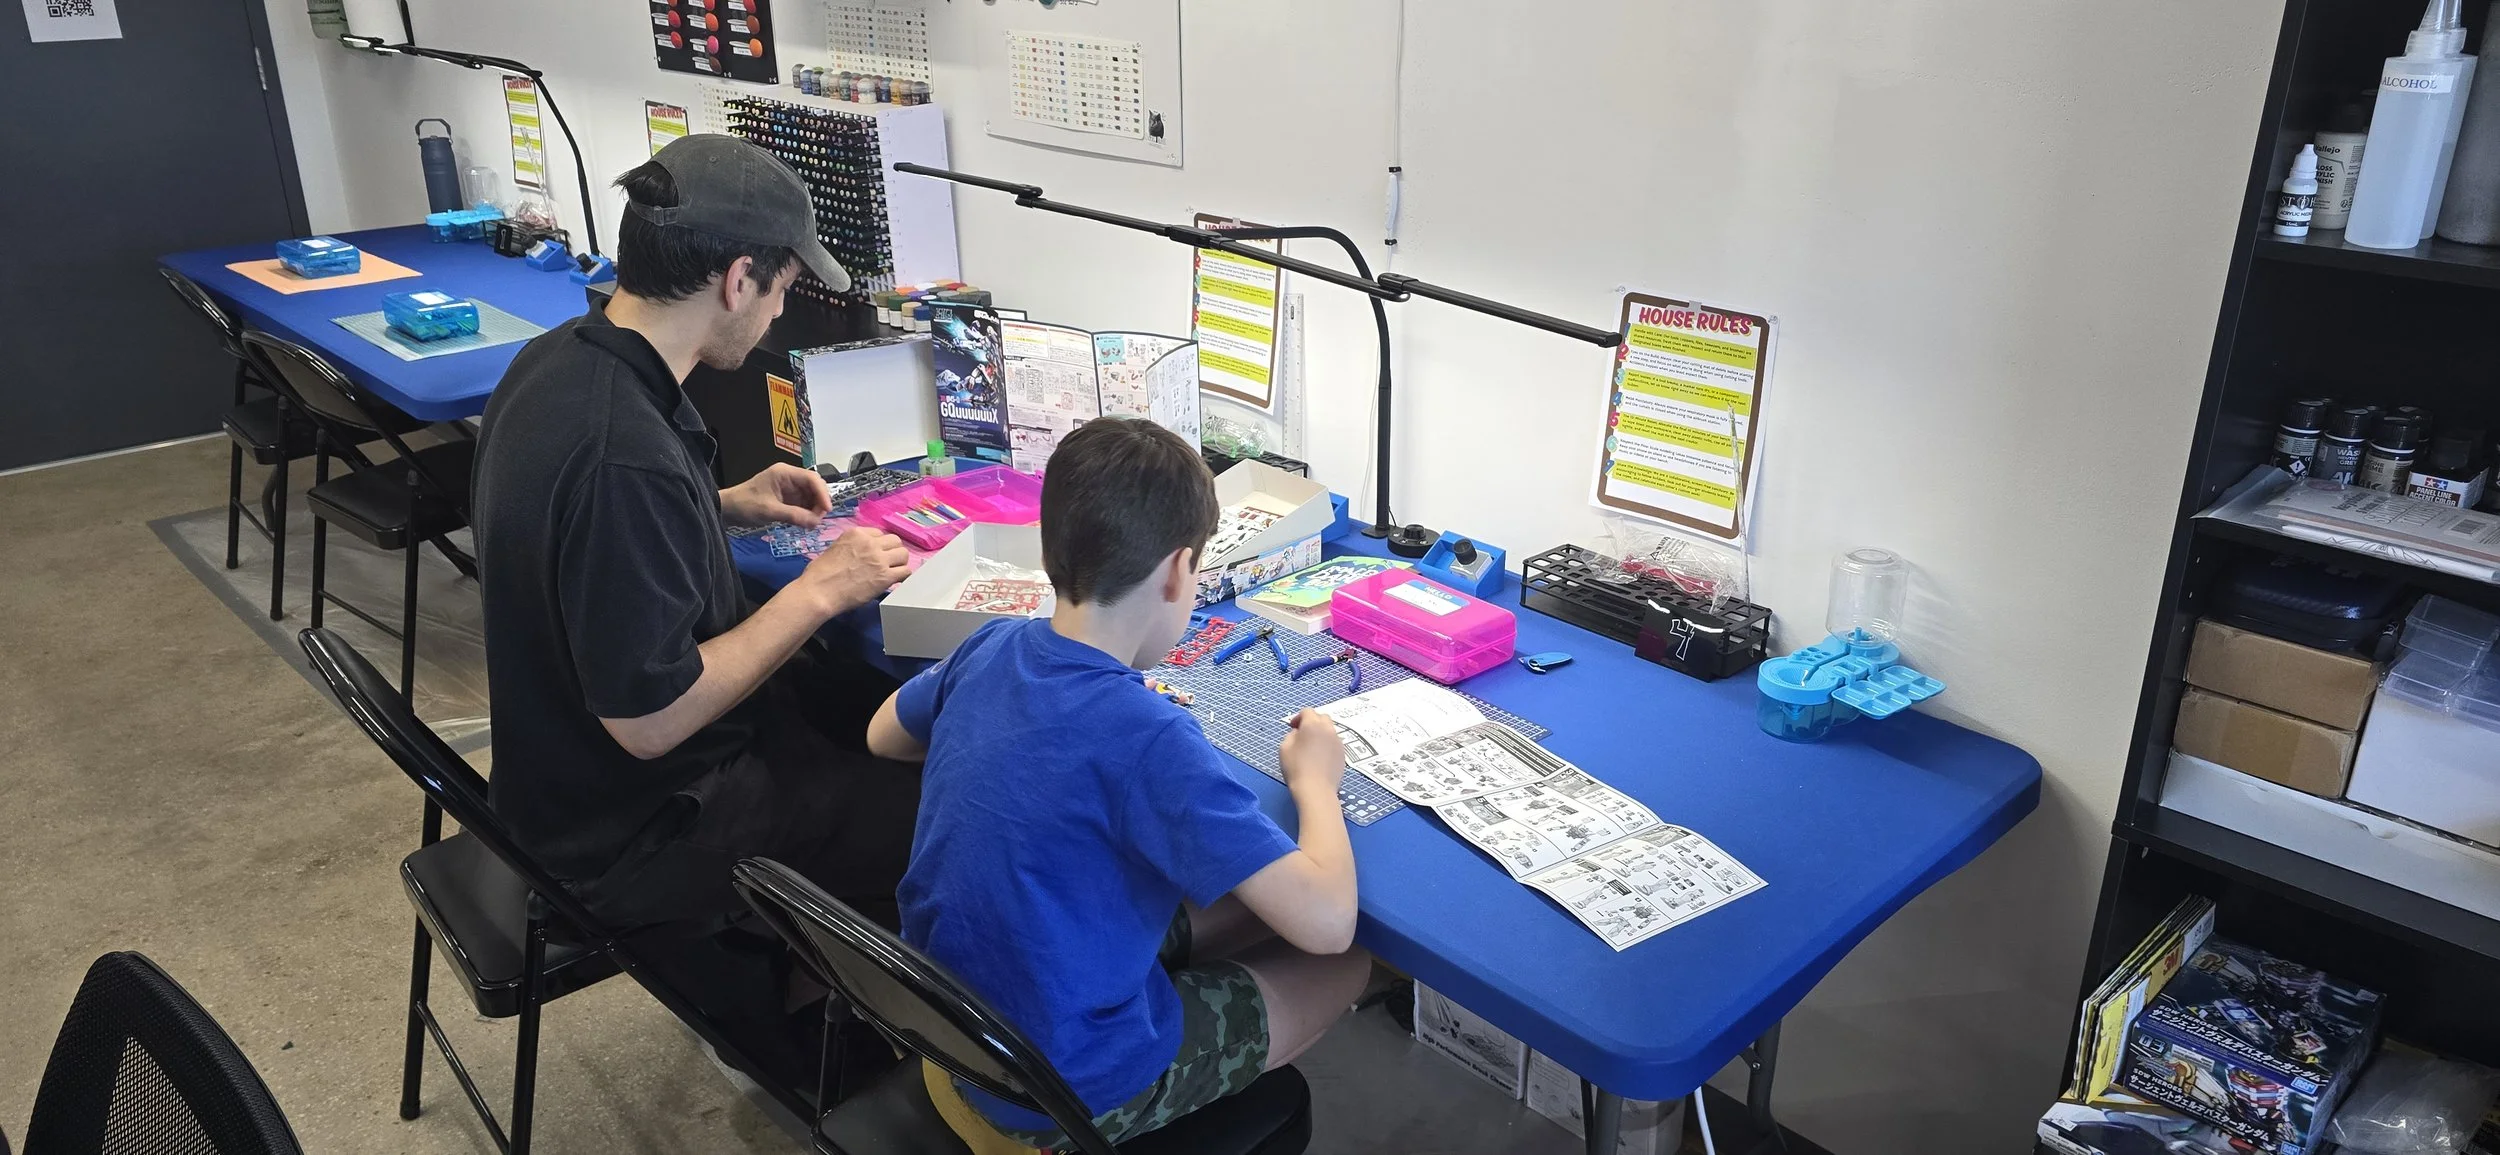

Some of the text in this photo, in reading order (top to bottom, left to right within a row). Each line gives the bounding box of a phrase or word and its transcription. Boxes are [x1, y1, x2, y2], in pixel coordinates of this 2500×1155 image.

[2382, 76, 2438, 90] ALCOHOL
[1639, 307, 1753, 335] HOUSE RULES
[1609, 411, 1620, 428] 5
[1606, 435, 1618, 453] 6
[2336, 448, 2360, 456] WAS
[2409, 492, 2457, 506] ACCENT COLOR
[2416, 487, 2453, 499] PANEL LINE
[2163, 947, 2179, 976] 3M
[2179, 1012, 2219, 1032] HEROES
[2138, 1033, 2166, 1054] 03
[2131, 1066, 2183, 1094] SDW HEROES
